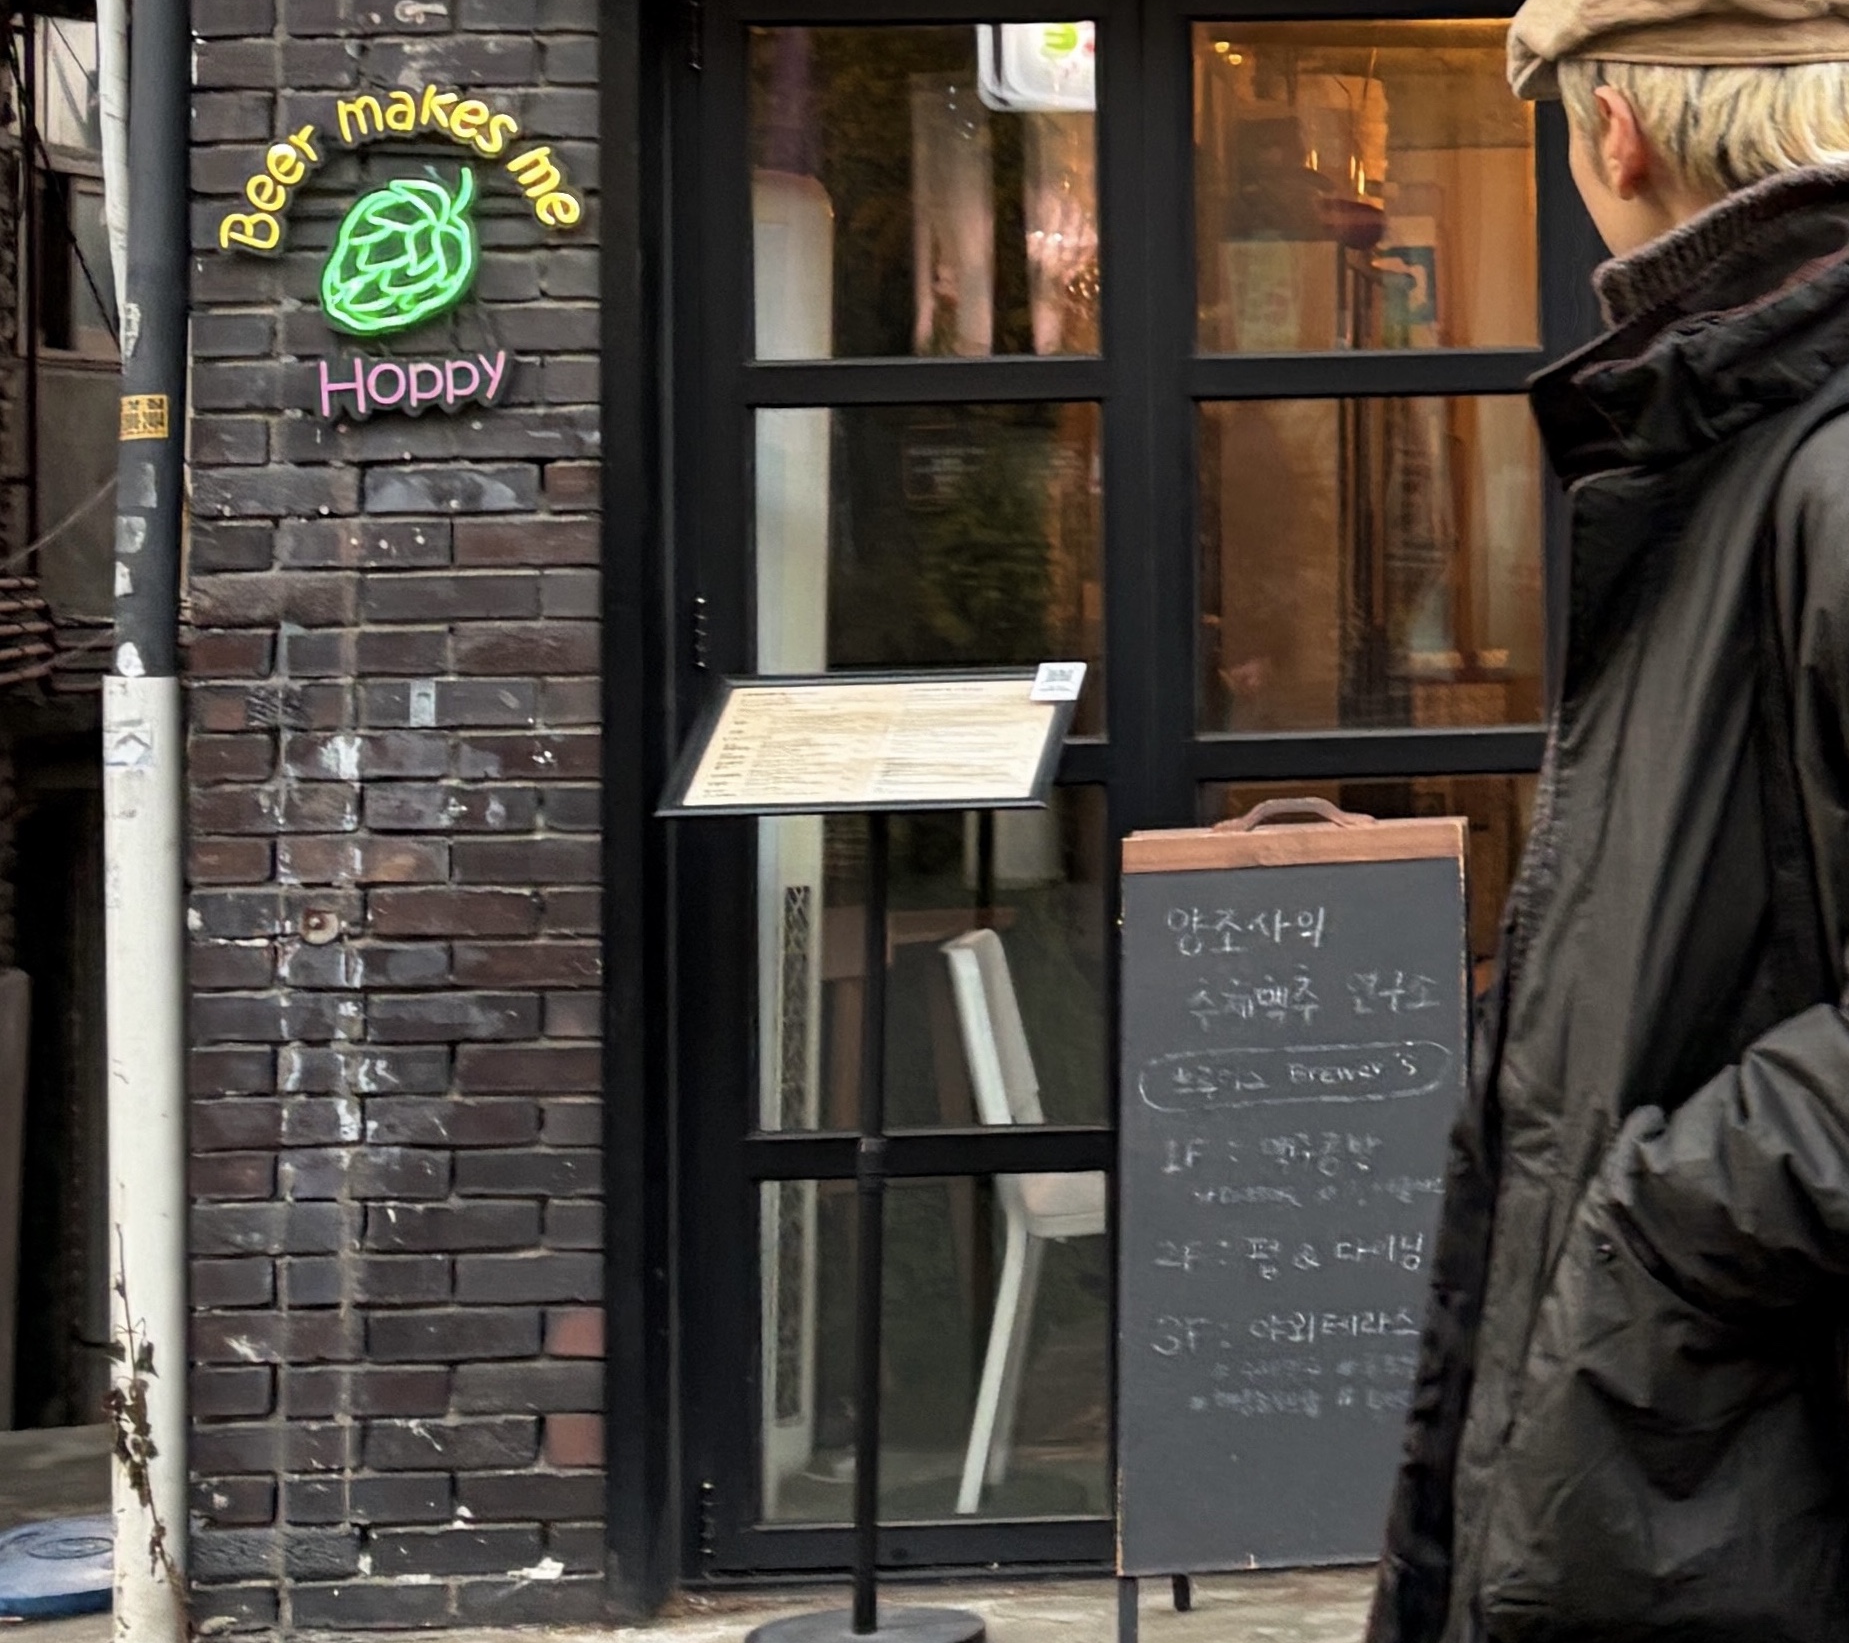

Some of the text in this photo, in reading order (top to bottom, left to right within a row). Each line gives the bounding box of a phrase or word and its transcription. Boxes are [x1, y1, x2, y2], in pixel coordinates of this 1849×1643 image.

[219, 83, 582, 250] Beer makes me
[317, 350, 507, 417] Hoppy
[1167, 907, 1325, 956] 양조사의
[1189, 962, 1320, 1032] 수제맥주
